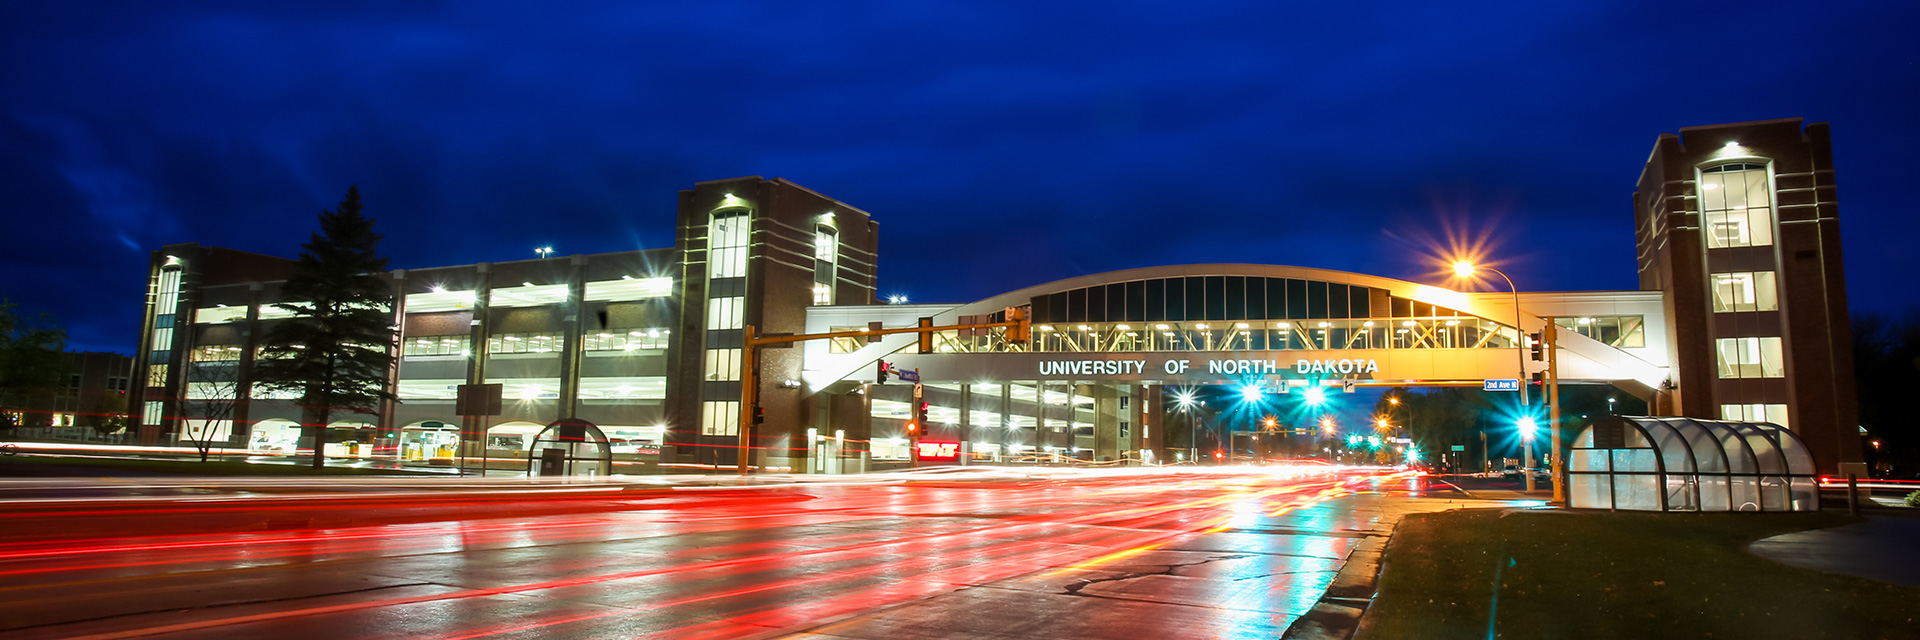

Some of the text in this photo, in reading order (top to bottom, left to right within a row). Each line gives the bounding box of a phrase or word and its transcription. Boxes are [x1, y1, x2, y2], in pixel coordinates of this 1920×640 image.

[1038, 358, 1380, 375] UNIVERSITY OF NORTH DAKOTA
[1487, 381, 1516, 389] 2nd Ave N
